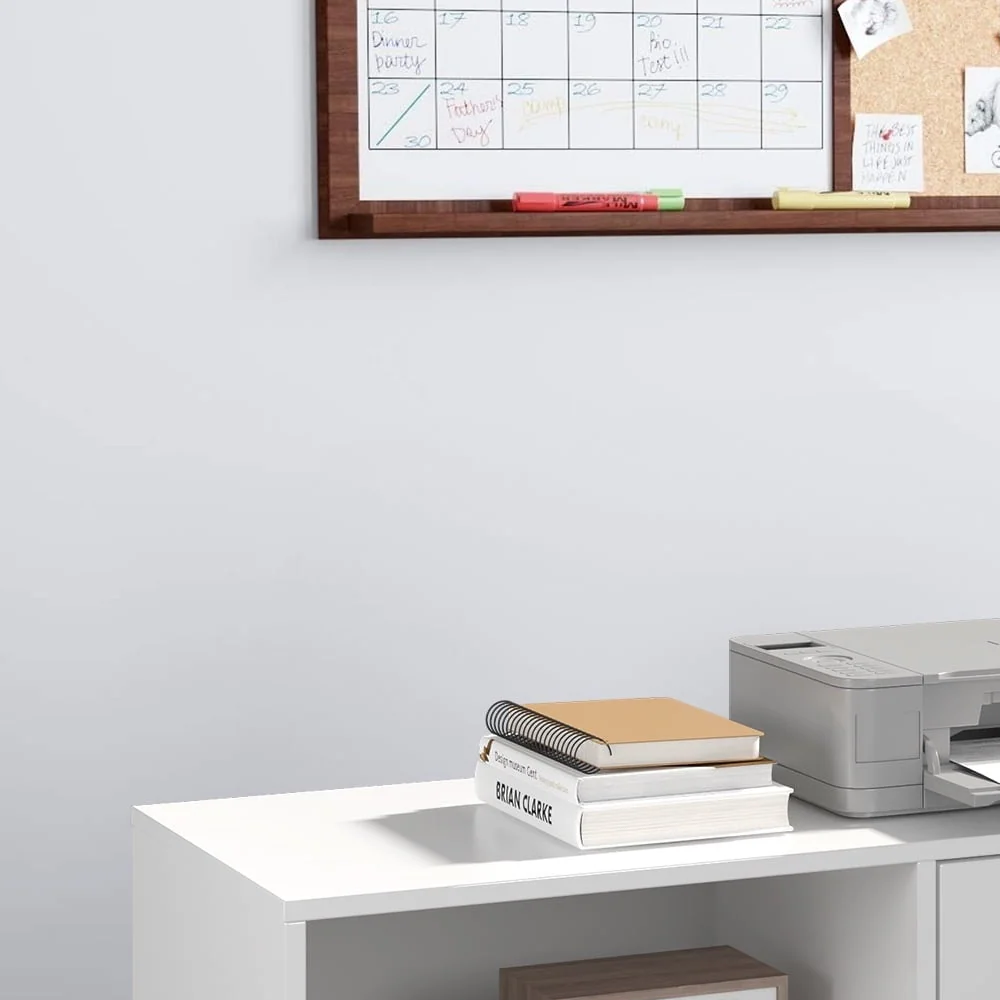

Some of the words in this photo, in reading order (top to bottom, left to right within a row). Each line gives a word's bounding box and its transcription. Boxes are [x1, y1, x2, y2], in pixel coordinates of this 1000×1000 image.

[371, 11, 399, 25] 16
[439, 12, 467, 29] 17
[505, 12, 530, 27] 18
[573, 13, 597, 33] 19
[636, 15, 662, 28] 20
[701, 15, 725, 29] 21
[764, 16, 792, 30] 22
[371, 30, 428, 49] Dinner
[375, 53, 427, 76] party
[371, 81, 400, 95] 23
[439, 81, 469, 96] 24
[506, 82, 536, 96] 25
[572, 82, 601, 97] 26
[637, 82, 667, 100] 27
[701, 83, 727, 98] 28
[764, 83, 789, 103] 29
[404, 134, 432, 149] 30
[495, 780, 521, 810] BRIAN
[522, 794, 553, 826] CLARKE
